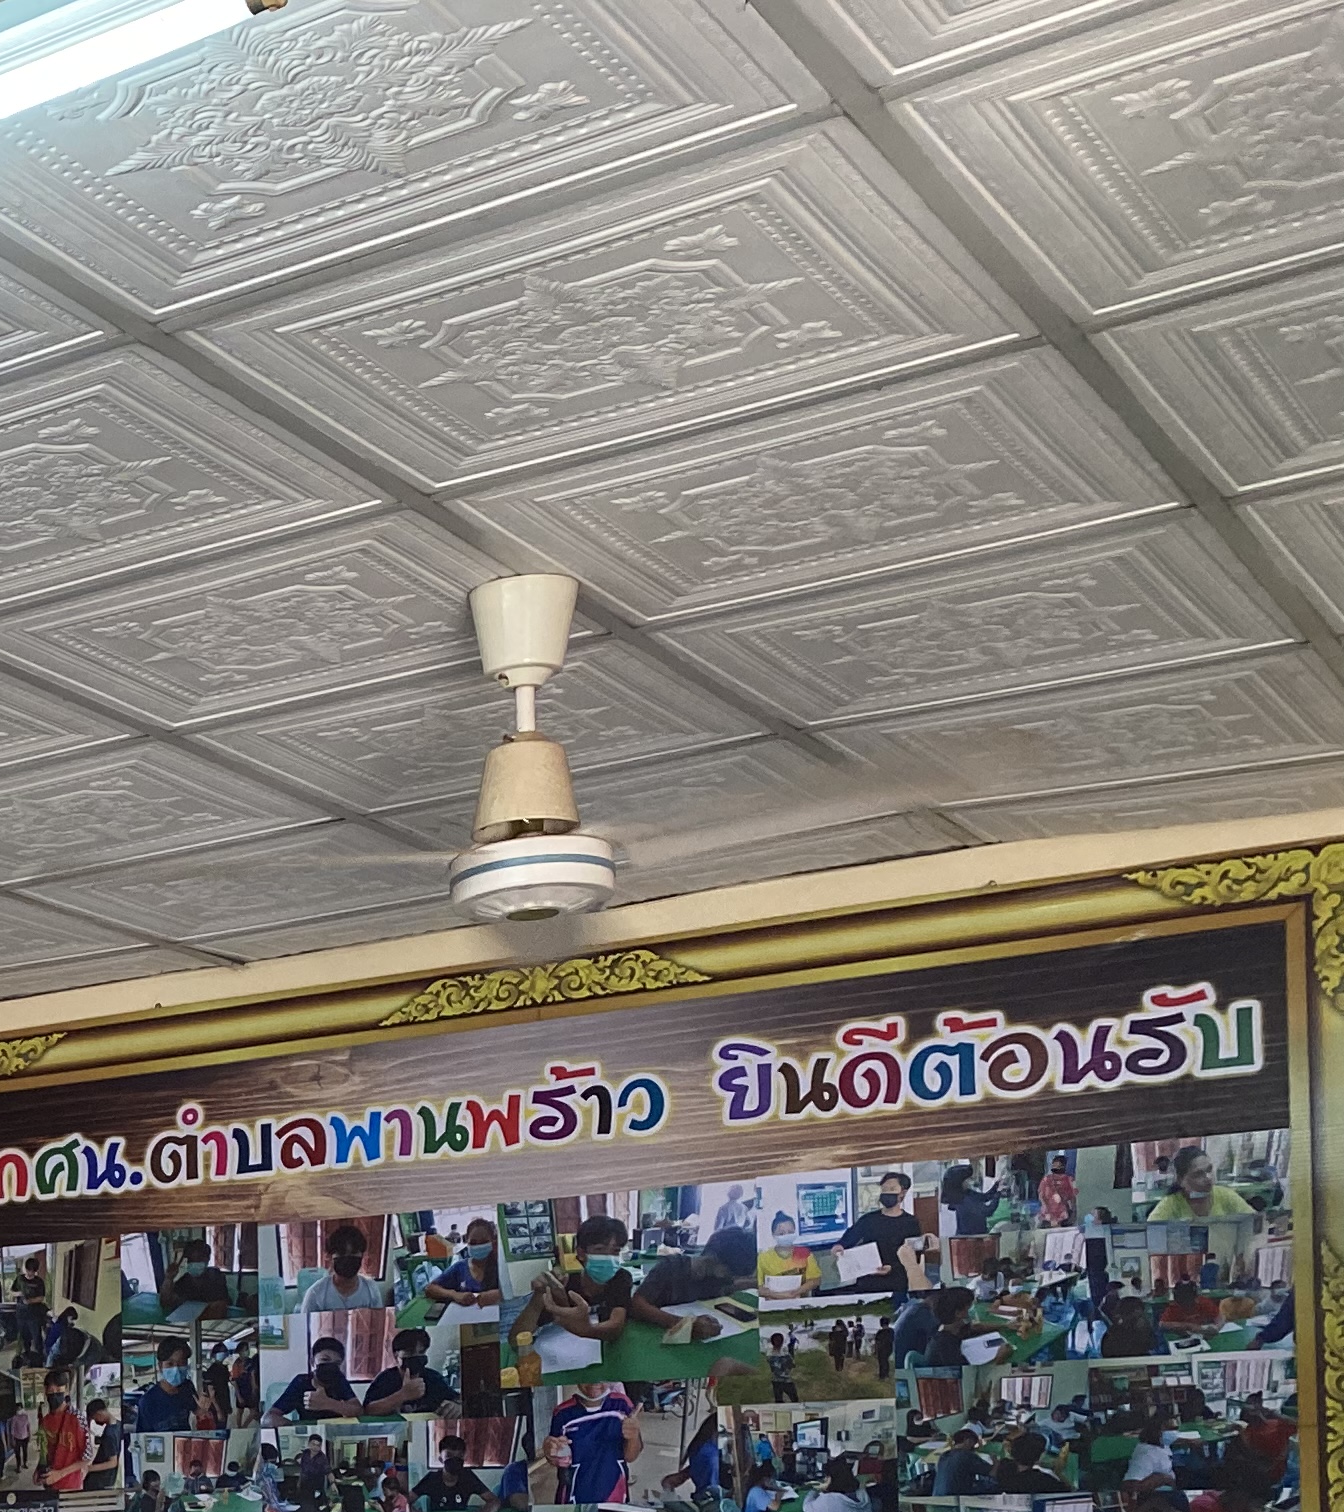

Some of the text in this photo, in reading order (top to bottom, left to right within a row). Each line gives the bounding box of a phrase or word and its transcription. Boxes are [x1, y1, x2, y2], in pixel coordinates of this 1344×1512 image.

[714, 985, 1264, 1128] ยินดีต้อนรับ
